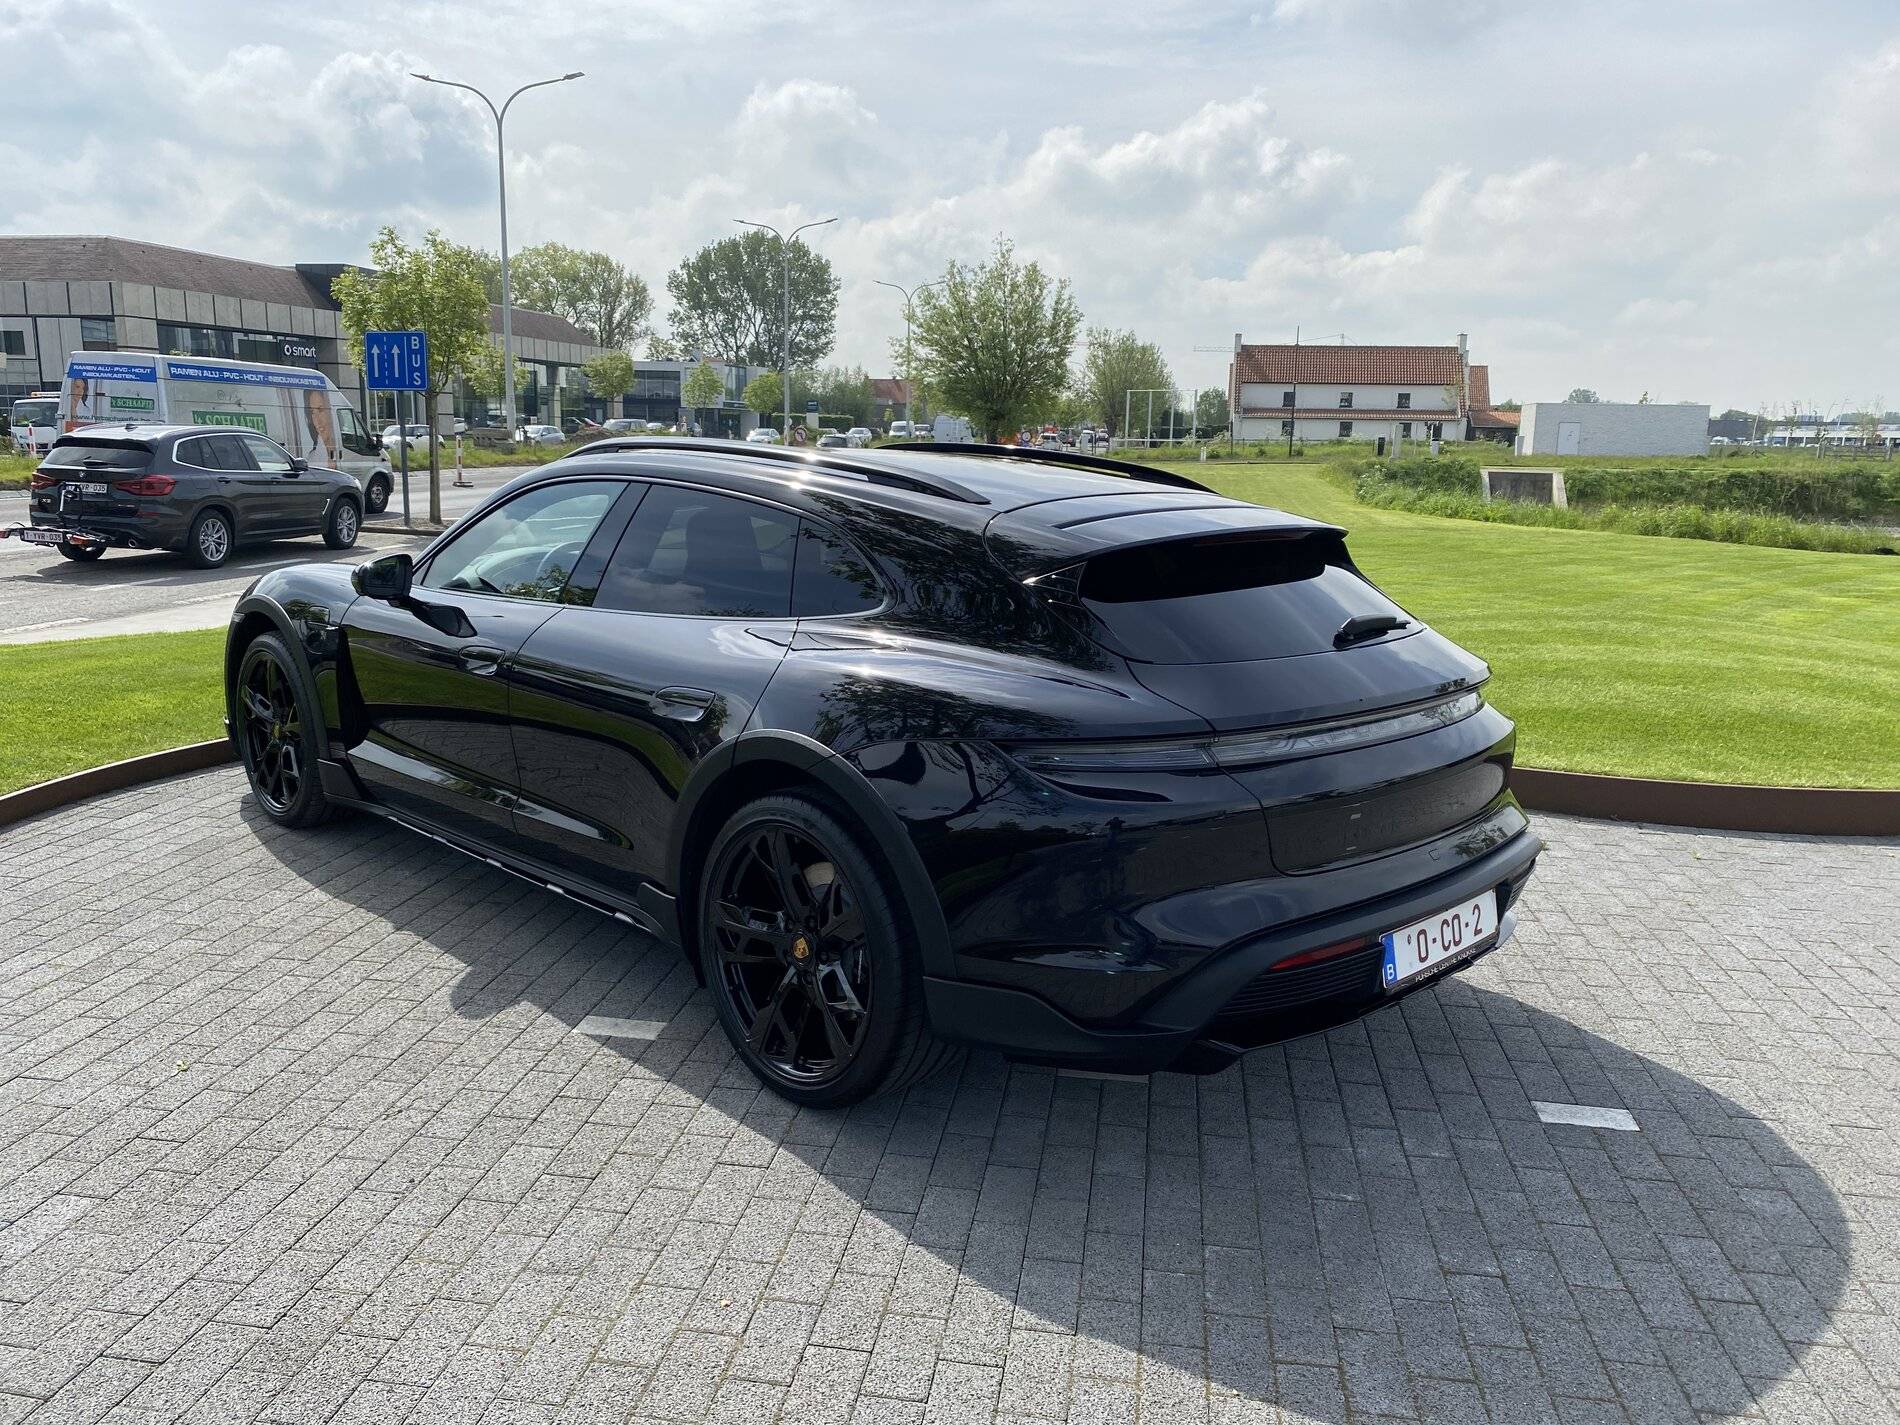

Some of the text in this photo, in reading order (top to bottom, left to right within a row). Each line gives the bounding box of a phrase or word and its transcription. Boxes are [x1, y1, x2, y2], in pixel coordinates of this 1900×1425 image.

[293, 345, 316, 358] smart
[73, 364, 97, 372] RAMEN
[97, 365, 110, 373] ALU
[114, 366, 128, 374] PVC
[131, 367, 152, 375] HOUT
[411, 336, 422, 386] BUS
[170, 366, 202, 377] RAMEN
[202, 369, 219, 379] ALU
[223, 371, 240, 380] PVC
[243, 374, 265, 383] HOUT
[1386, 963, 1395, 980] B
